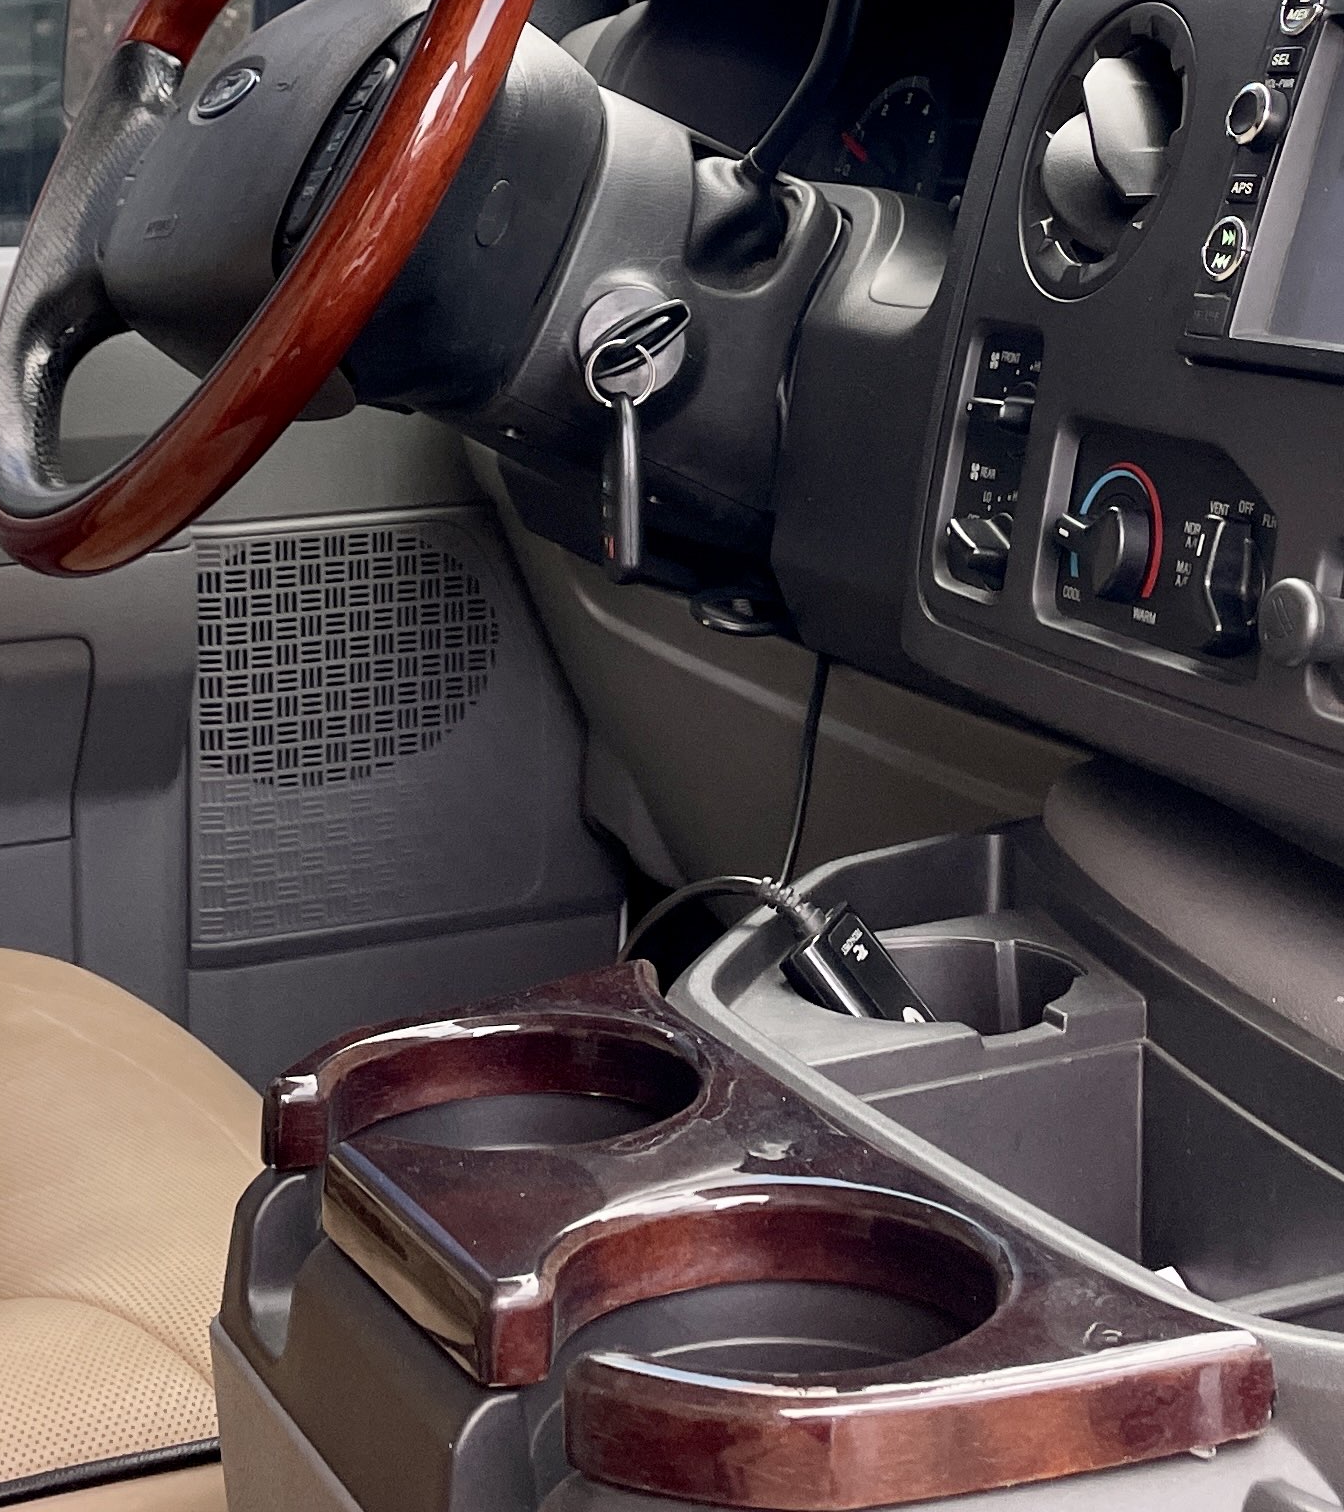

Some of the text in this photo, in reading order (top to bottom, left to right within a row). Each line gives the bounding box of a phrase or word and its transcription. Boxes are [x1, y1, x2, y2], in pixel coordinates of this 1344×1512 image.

[1271, 53, 1290, 66] SEL
[1231, 181, 1254, 195] APS
[1001, 351, 1021, 364] FRONT
[980, 466, 996, 480] REAR
[1210, 501, 1230, 516] VENT
[1238, 499, 1255, 514] OFF
[1063, 585, 1081, 602] COOL
[1133, 607, 1157, 625] WARM
